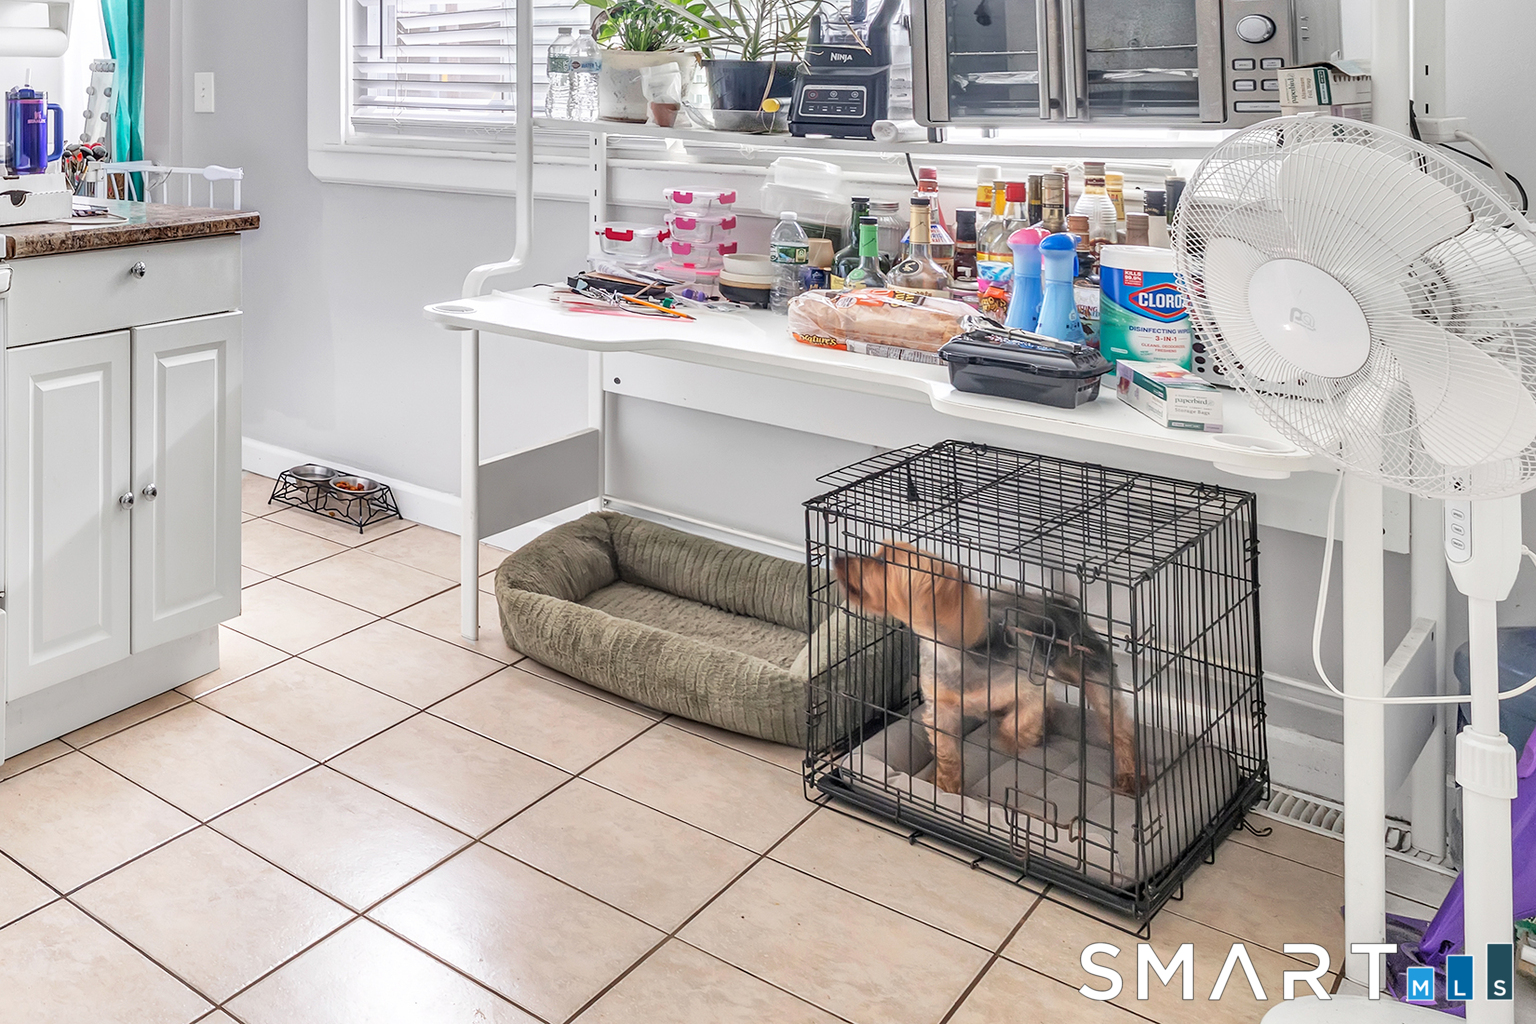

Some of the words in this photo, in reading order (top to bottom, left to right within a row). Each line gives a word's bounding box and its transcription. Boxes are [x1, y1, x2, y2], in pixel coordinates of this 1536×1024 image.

[830, 52, 853, 63] NINJA
[1138, 292, 1186, 309] CLORO
[1129, 326, 1177, 334] DISINFECTING
[1175, 397, 1208, 406] paperbird
